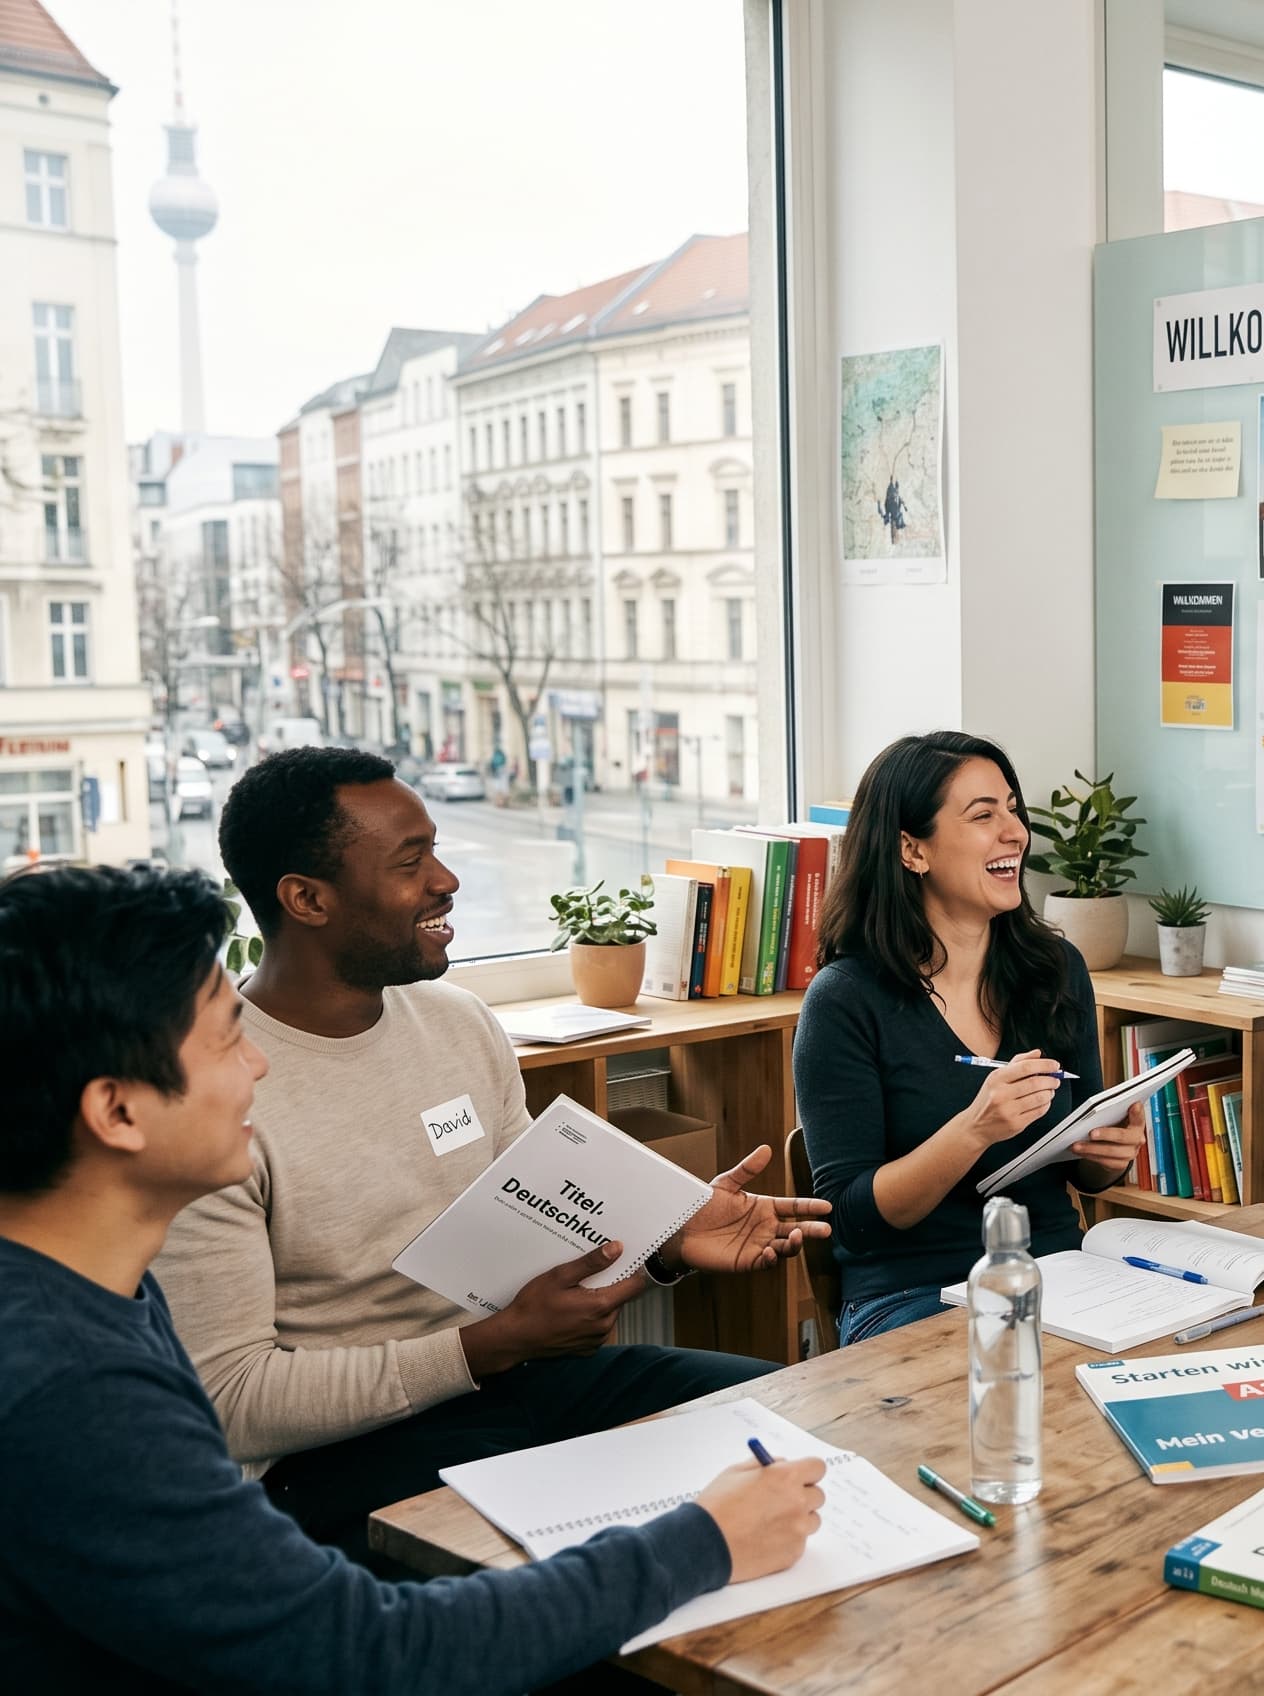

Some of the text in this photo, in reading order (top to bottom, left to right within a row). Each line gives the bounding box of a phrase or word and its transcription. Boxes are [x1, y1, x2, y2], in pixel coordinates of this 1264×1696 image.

[428, 1108, 472, 1140] David
[1112, 1363, 1219, 1384] Starten
[1156, 1430, 1226, 1451] Mein
